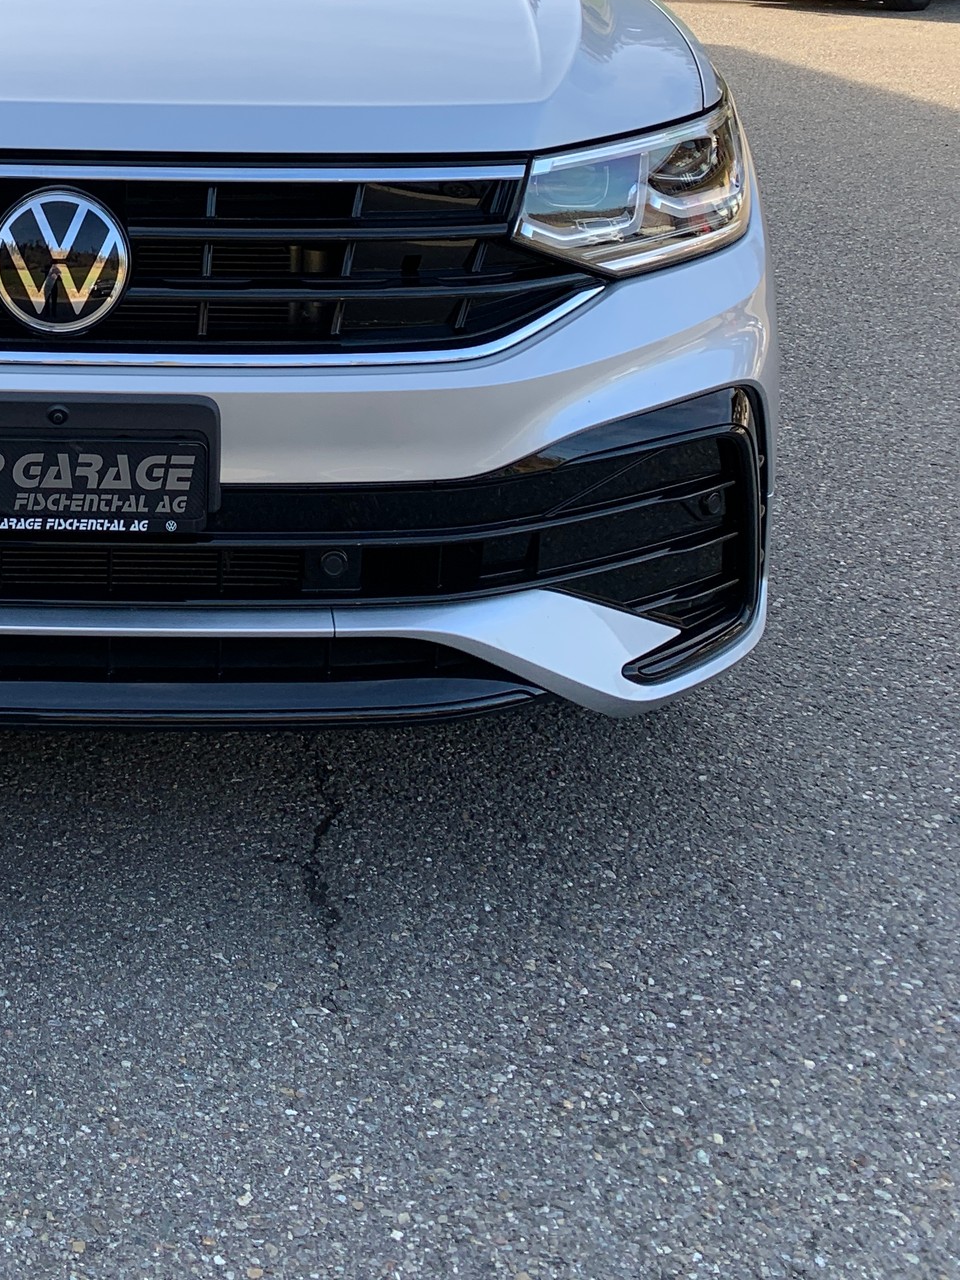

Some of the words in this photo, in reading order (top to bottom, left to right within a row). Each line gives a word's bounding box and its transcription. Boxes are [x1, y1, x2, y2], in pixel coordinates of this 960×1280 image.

[12, 452, 196, 491] GARAGE
[14, 493, 149, 513] FISCHENTHAL
[154, 495, 188, 514] AG
[46, 518, 126, 531] FISCHENTHAL
[129, 519, 149, 532] AG
